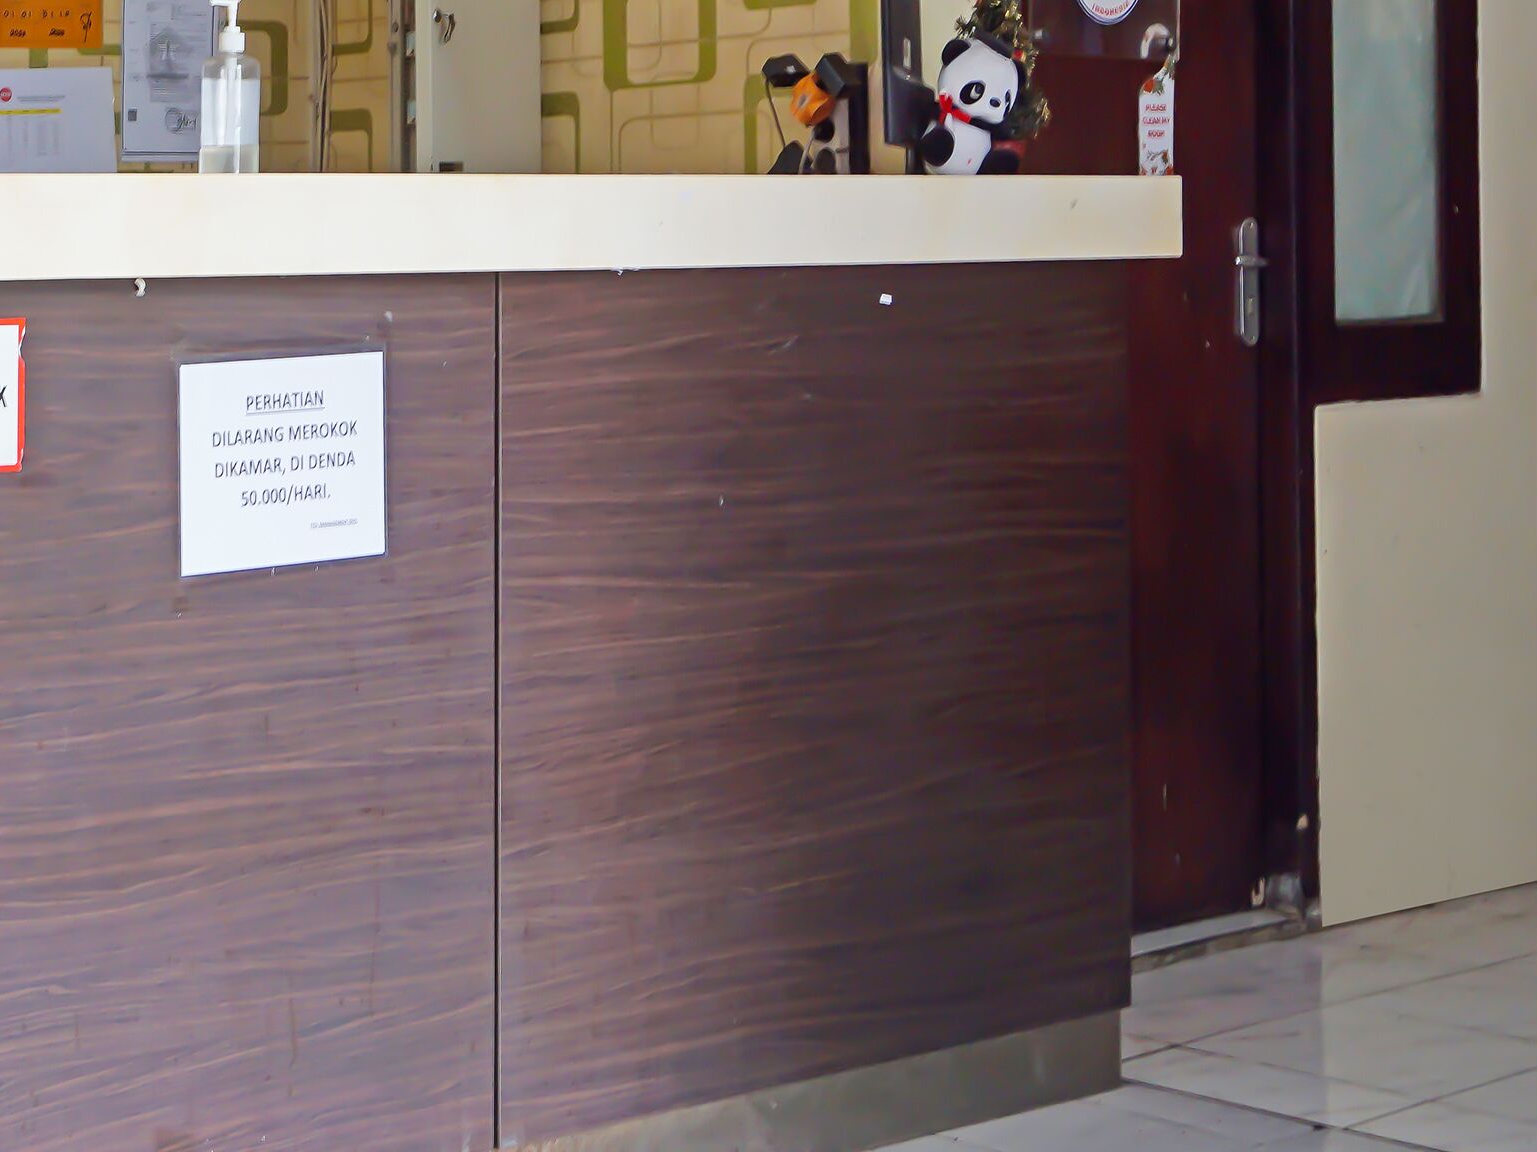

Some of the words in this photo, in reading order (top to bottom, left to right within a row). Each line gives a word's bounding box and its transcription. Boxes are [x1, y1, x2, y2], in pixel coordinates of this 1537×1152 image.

[246, 389, 324, 412] PERHATIAN
[212, 426, 284, 448] DILARANG
[288, 419, 358, 441] MEROKOK
[214, 456, 286, 479] DIKAMAR,
[290, 454, 304, 472] DI
[308, 450, 356, 470] DENDA
